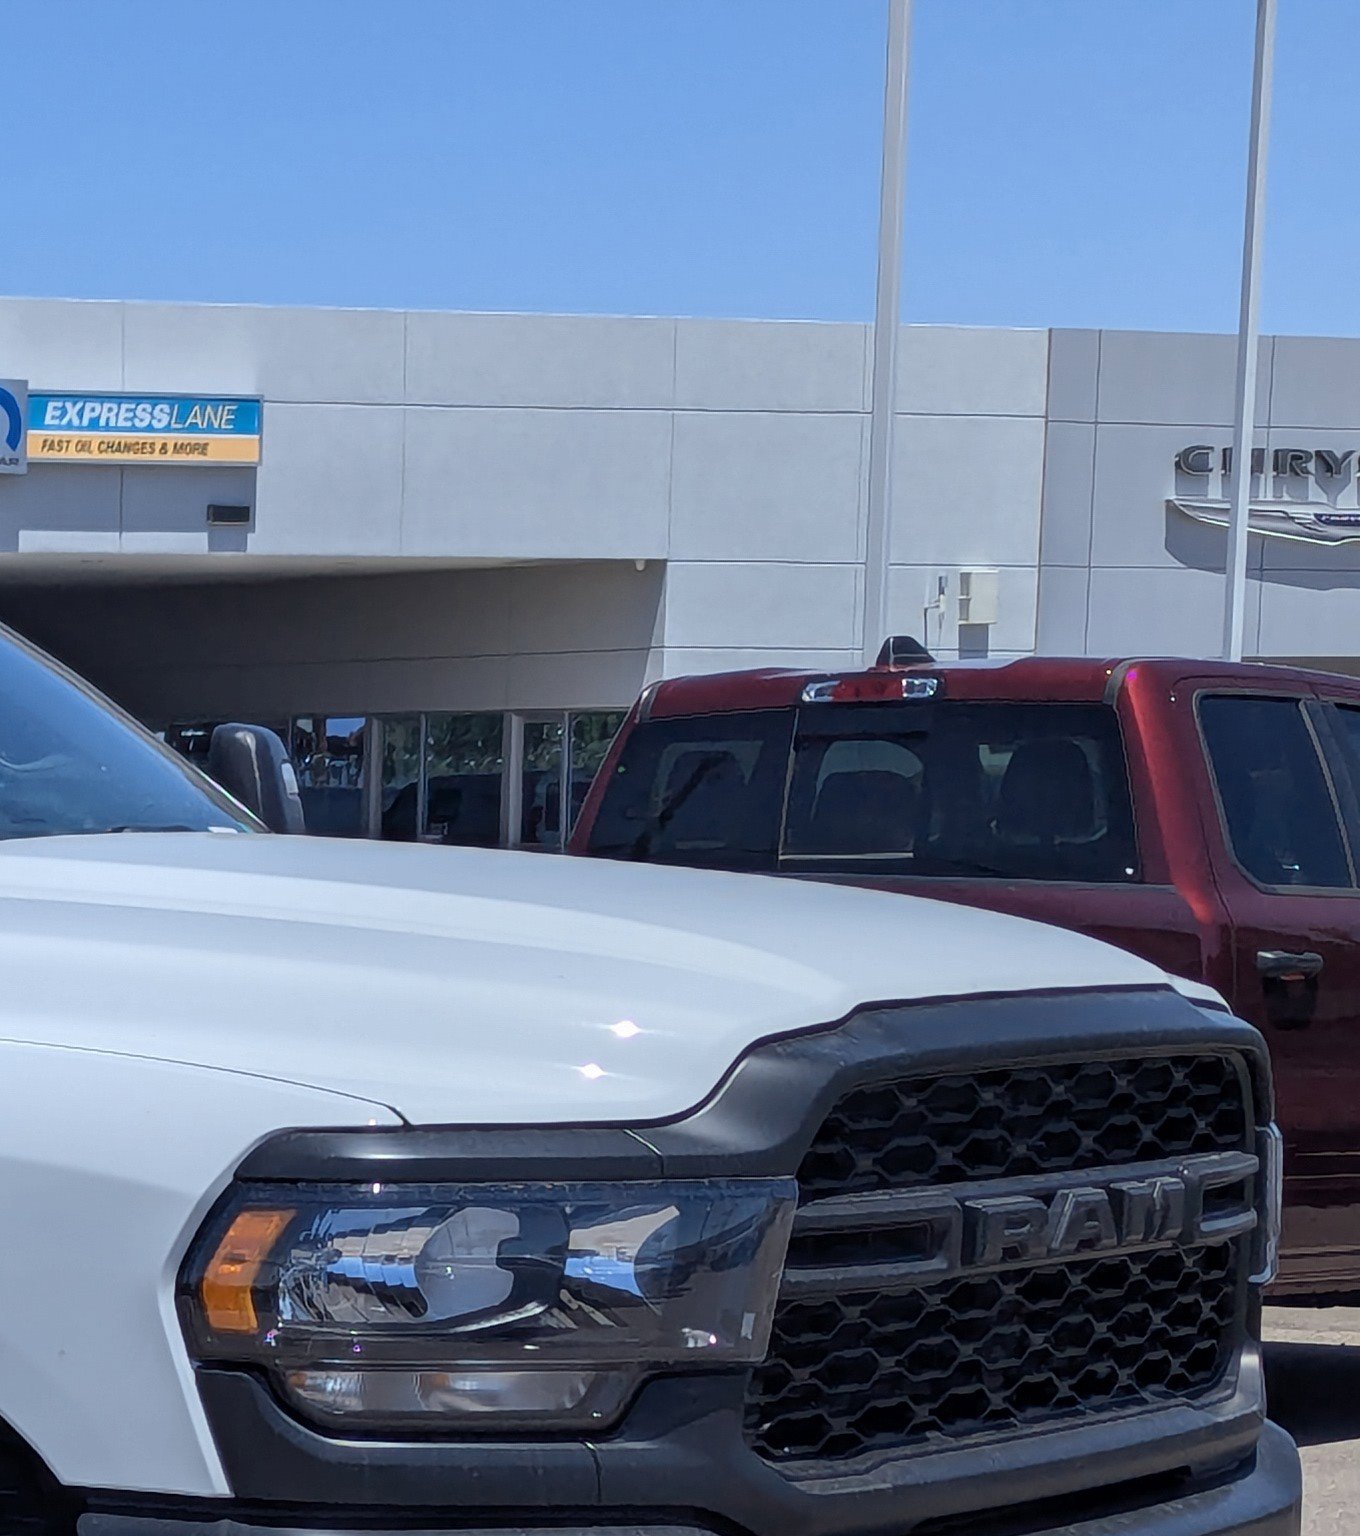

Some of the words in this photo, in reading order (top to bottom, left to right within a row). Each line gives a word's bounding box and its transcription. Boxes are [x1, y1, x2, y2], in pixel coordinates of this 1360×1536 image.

[41, 439, 70, 452] FAST
[97, 440, 156, 455] CHANGES
[159, 443, 167, 455] &
[172, 442, 209, 456] MORE
[1174, 444, 1360, 478] CHRY
[964, 1177, 1185, 1264] RAM
